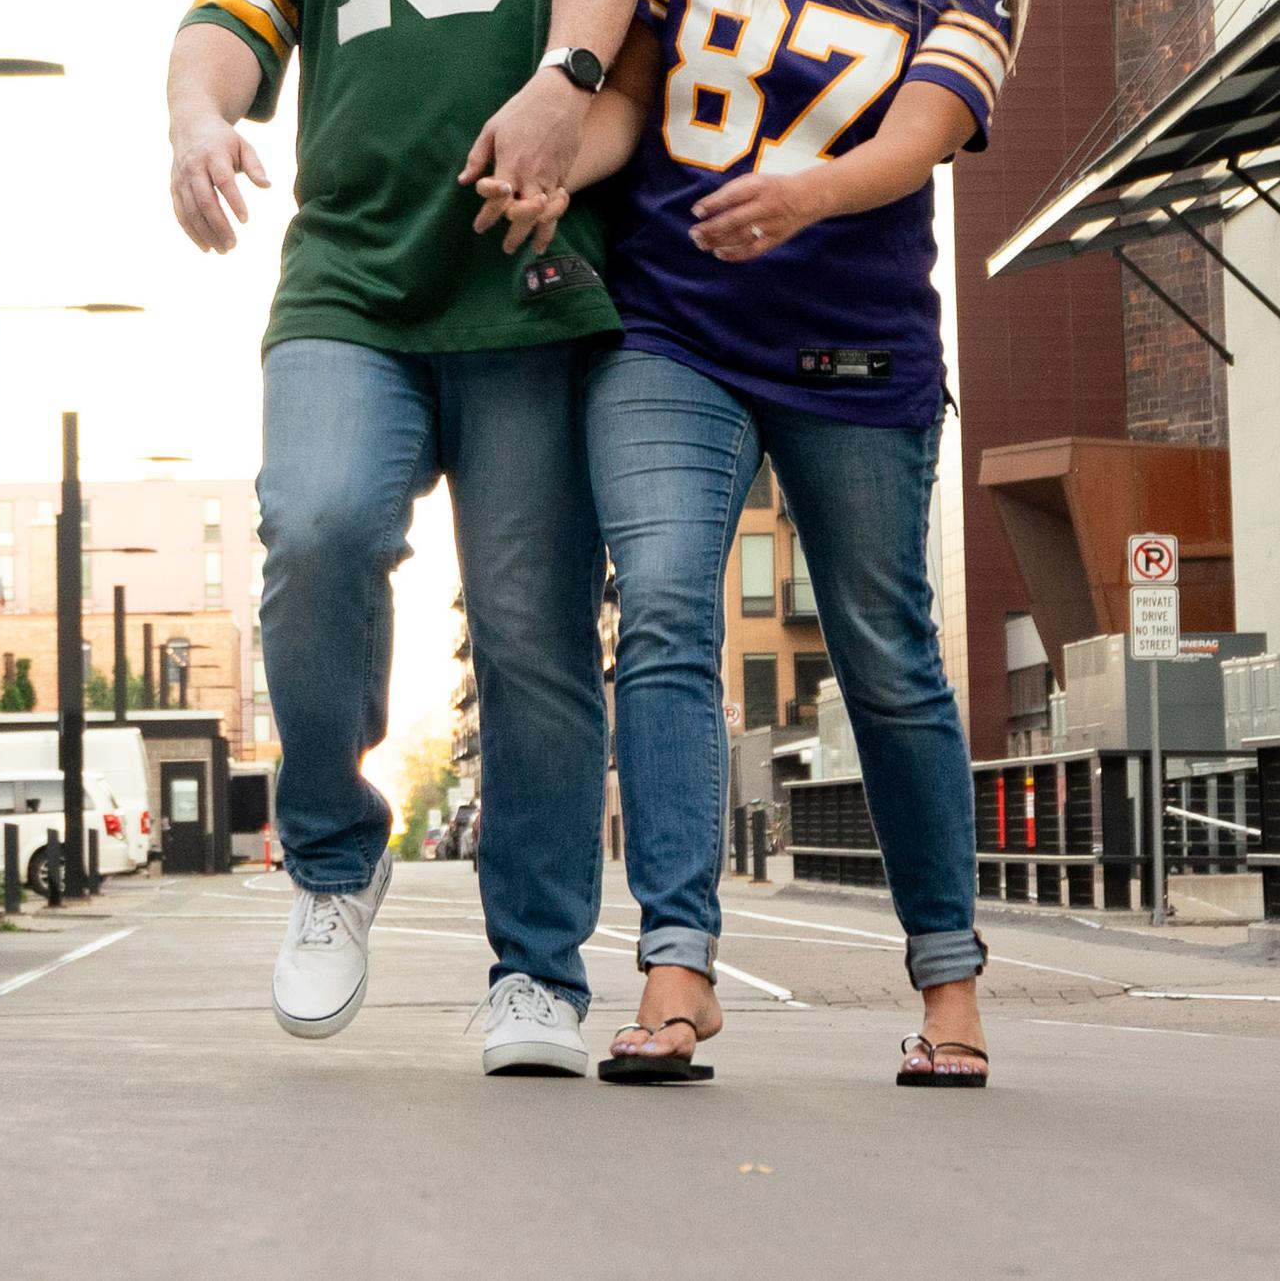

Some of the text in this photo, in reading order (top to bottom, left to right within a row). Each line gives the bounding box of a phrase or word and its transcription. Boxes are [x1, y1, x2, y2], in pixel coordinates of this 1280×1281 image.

[1144, 547, 1164, 572] P
[1136, 596, 1173, 607] PRIVATE
[1141, 611, 1168, 621] DRIVE
[1135, 625, 1175, 636] NO THRU
[1139, 639, 1172, 651] STREET
